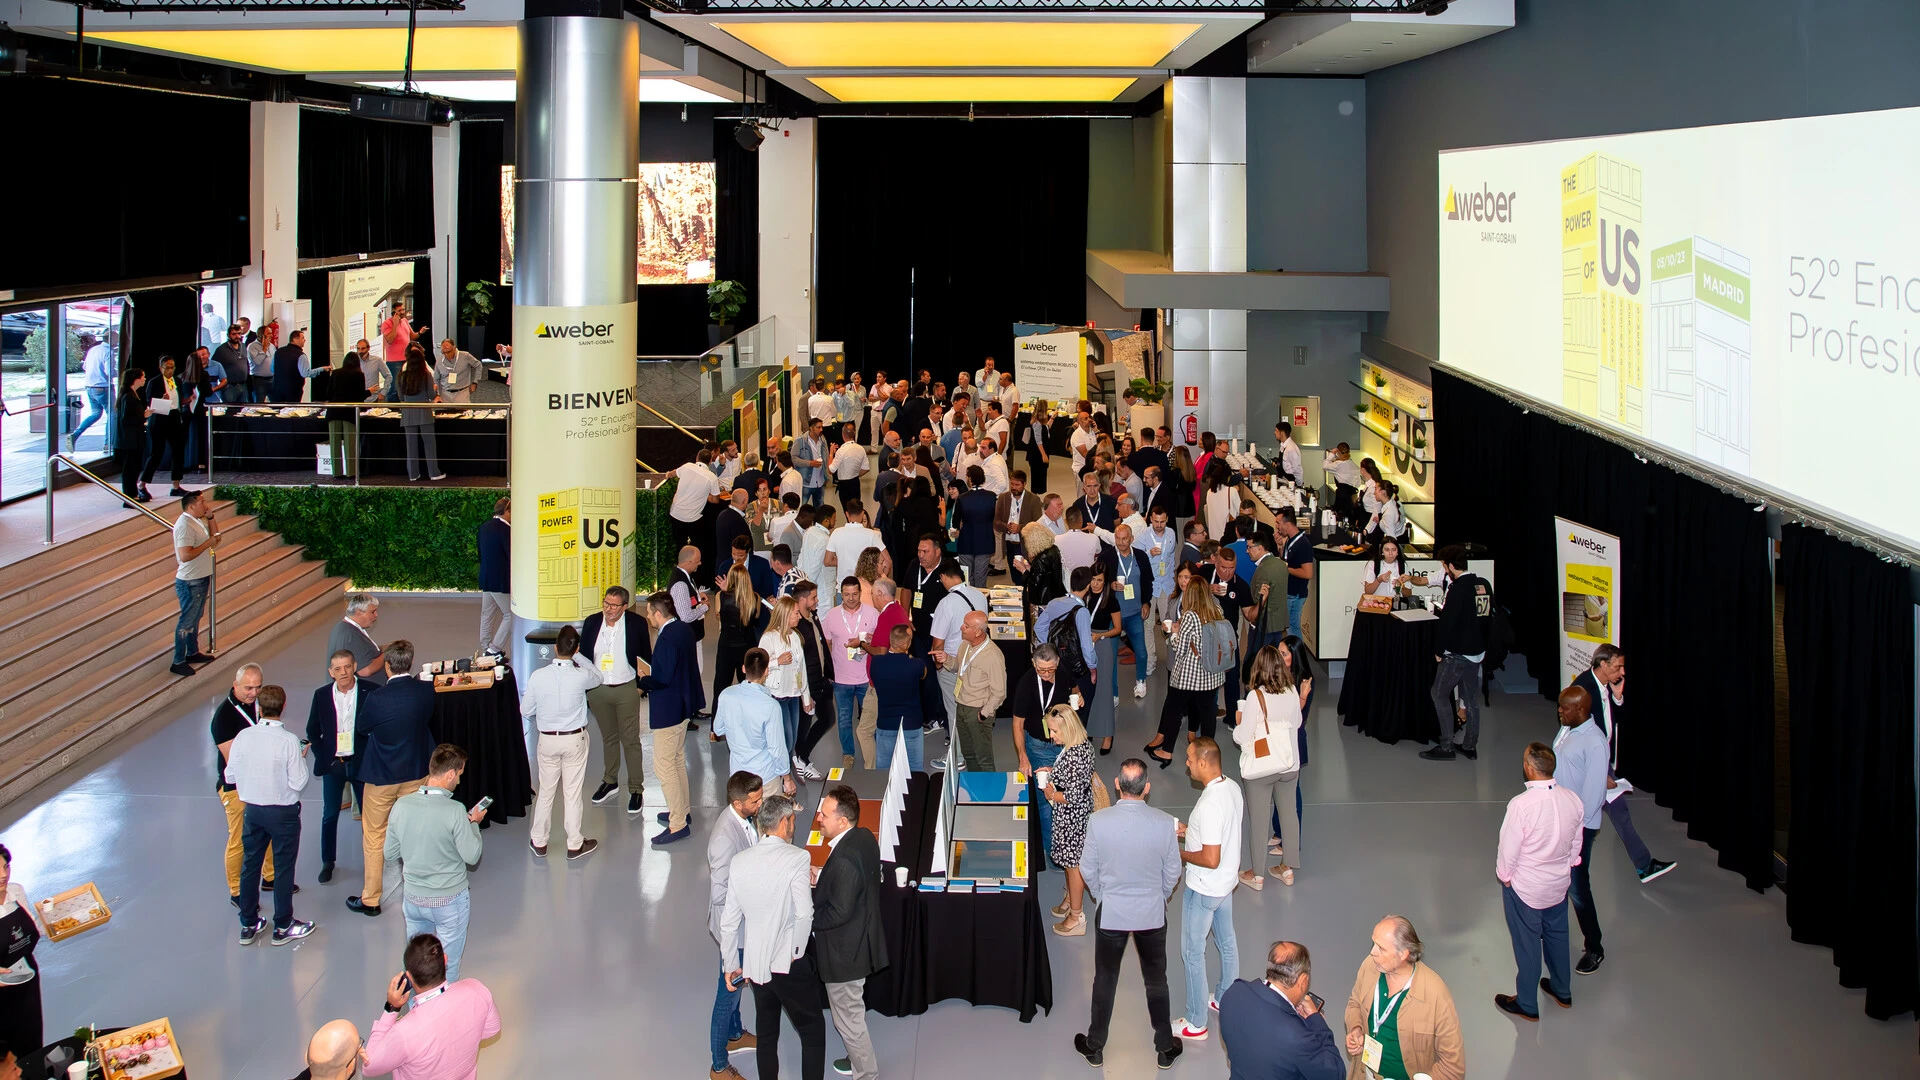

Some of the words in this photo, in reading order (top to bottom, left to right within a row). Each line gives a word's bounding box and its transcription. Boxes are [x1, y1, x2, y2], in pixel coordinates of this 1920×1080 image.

[1563, 173, 1577, 194] THE
[1458, 181, 1516, 223] weber
[1565, 210, 1592, 234] POWER
[1480, 231, 1517, 244] SAINT-GOBAIN
[1600, 217, 1641, 296] US
[1656, 249, 1686, 270] 05/10/23
[1583, 260, 1595, 280] OF
[1703, 272, 1745, 305] MADRID
[551, 321, 615, 338] weber
[1029, 342, 1057, 352] weber
[1373, 401, 1390, 421] POWER
[565, 426, 621, 440] Profesional
[1384, 444, 1391, 457] OF
[540, 497, 556, 507] THE
[541, 515, 573, 528] POWER
[583, 518, 620, 549] US
[563, 539, 576, 550] OF
[1575, 535, 1606, 554] weber
[1592, 575, 1609, 586] sistema
[1477, 597, 1489, 615] 67
